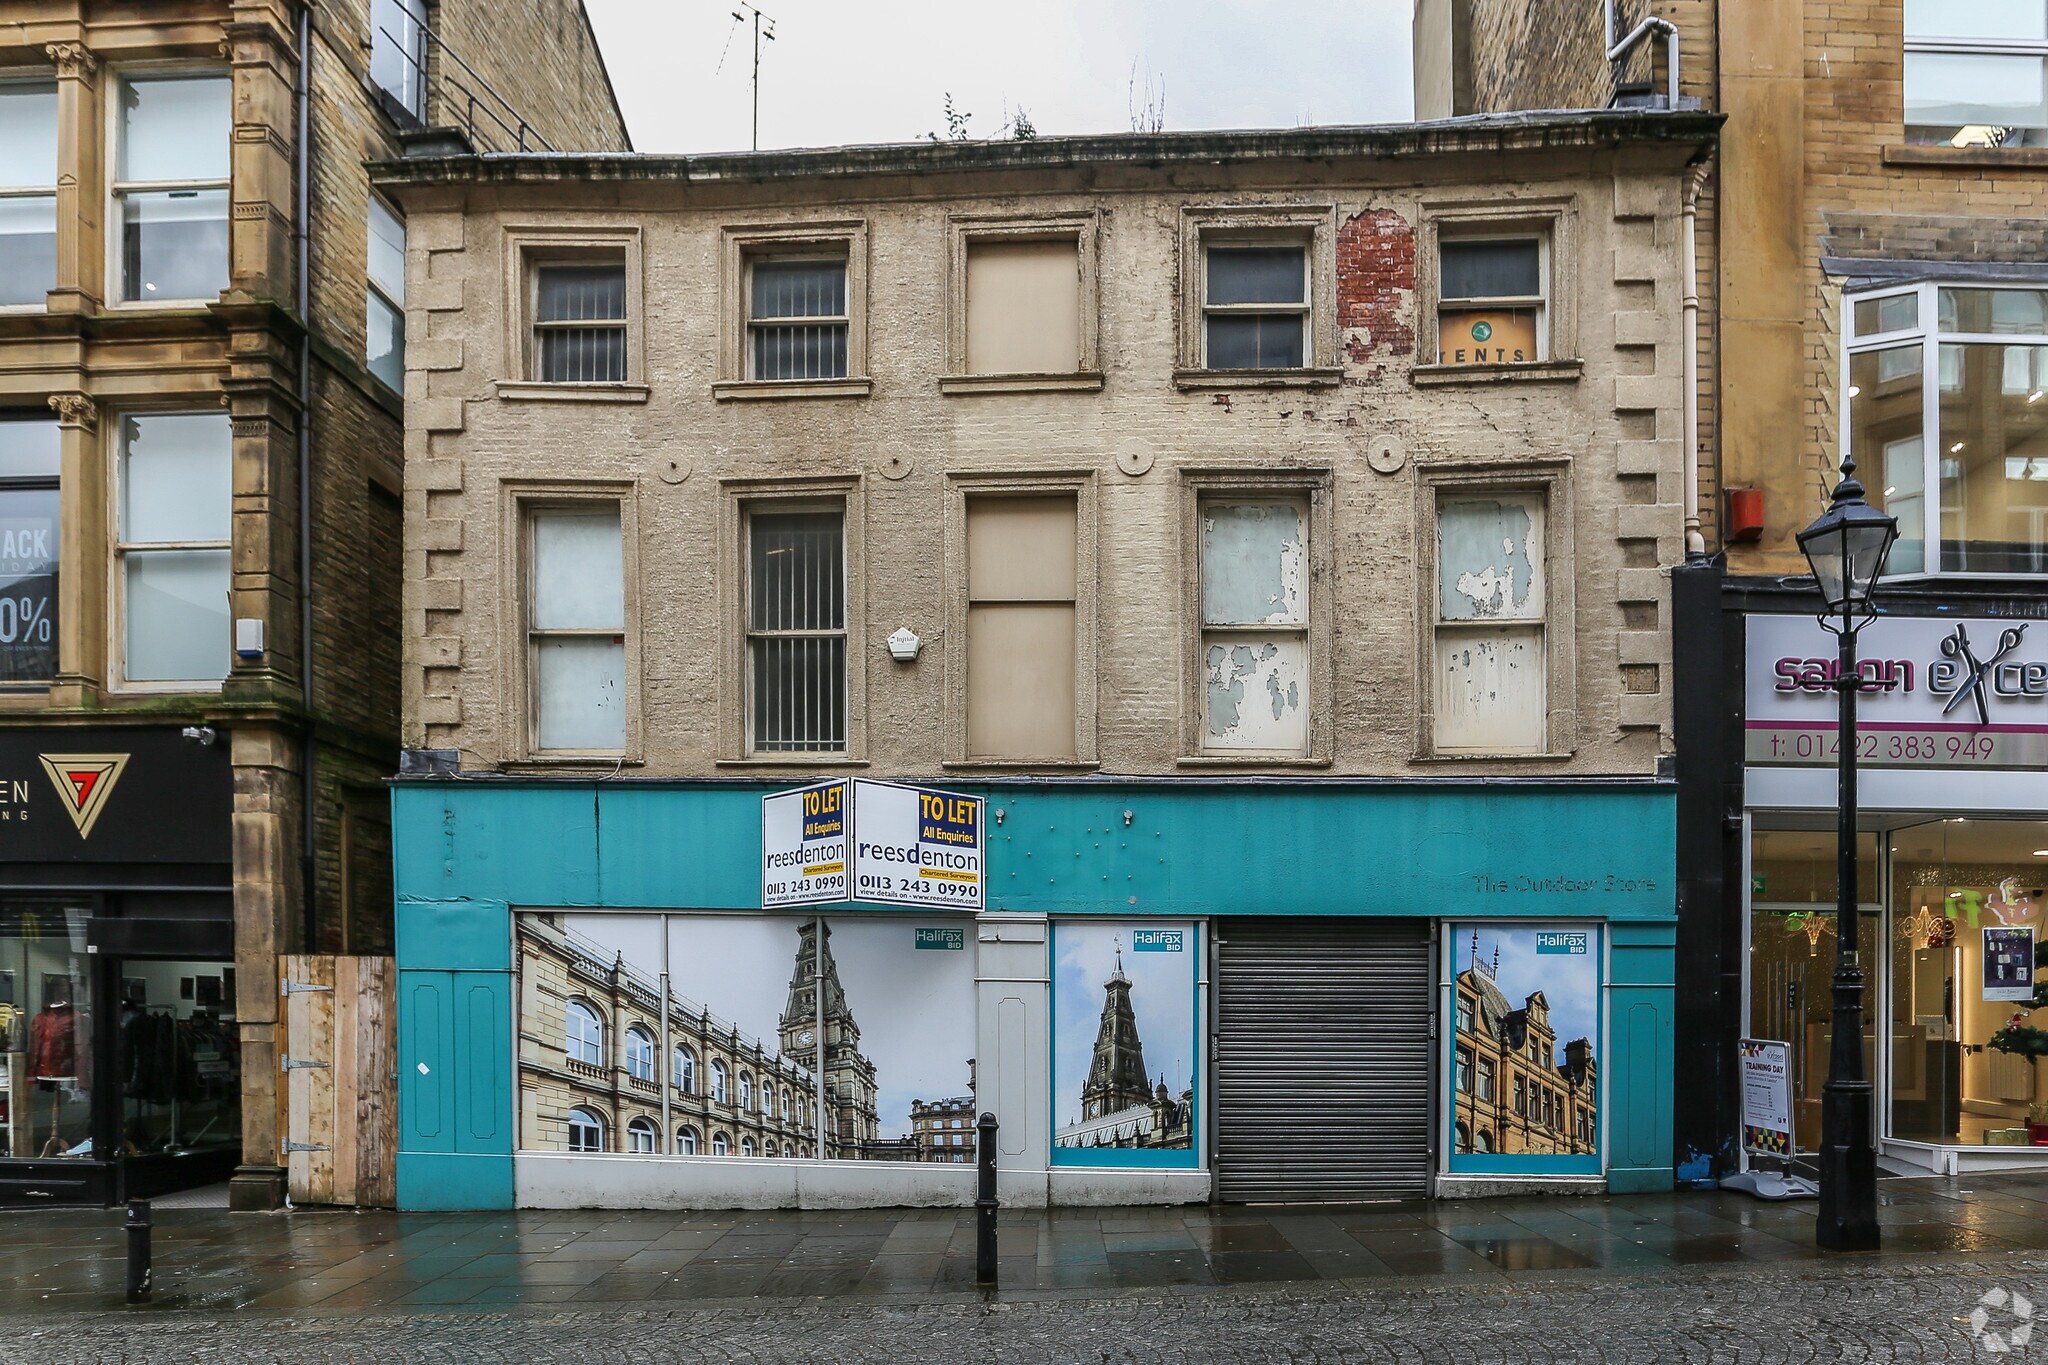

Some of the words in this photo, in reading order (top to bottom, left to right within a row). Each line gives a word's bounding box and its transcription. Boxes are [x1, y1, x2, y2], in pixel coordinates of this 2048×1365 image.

[1888, 735, 1936, 759] 383
[1945, 736, 1994, 760] 949
[804, 791, 820, 817] TO
[822, 786, 843, 814] LET
[920, 795, 944, 820] TO
[948, 799, 976, 825] LET
[805, 823, 814, 836] All
[814, 819, 841, 836] Enquiries
[923, 826, 935, 838] All
[936, 828, 974, 844] Enquiries
[767, 842, 844, 869] reesdenton
[859, 843, 978, 870] reesdenton
[803, 865, 823, 874] Chartered
[824, 862, 843, 871] Surveyors
[920, 869, 949, 878] Chartered
[949, 872, 976, 880] Surveyors
[767, 882, 786, 895] 0113
[791, 879, 811, 893] 243
[815, 875, 844, 890] 0990
[859, 875, 892, 889] 0113
[900, 879, 930, 893] 243
[938, 883, 978, 897] 0990
[799, 889, 845, 899] www.reesdenton.com
[876, 890, 898, 898] details
[913, 894, 979, 906] www.reesdenton.com
[916, 930, 962, 941] Halifax
[1134, 932, 1182, 944] Halifax
[1537, 934, 1586, 946] Halifax
[1570, 946, 1585, 954] BID
[1746, 1062, 1772, 1072] TRAINING
[1772, 1065, 1784, 1074] DAY
